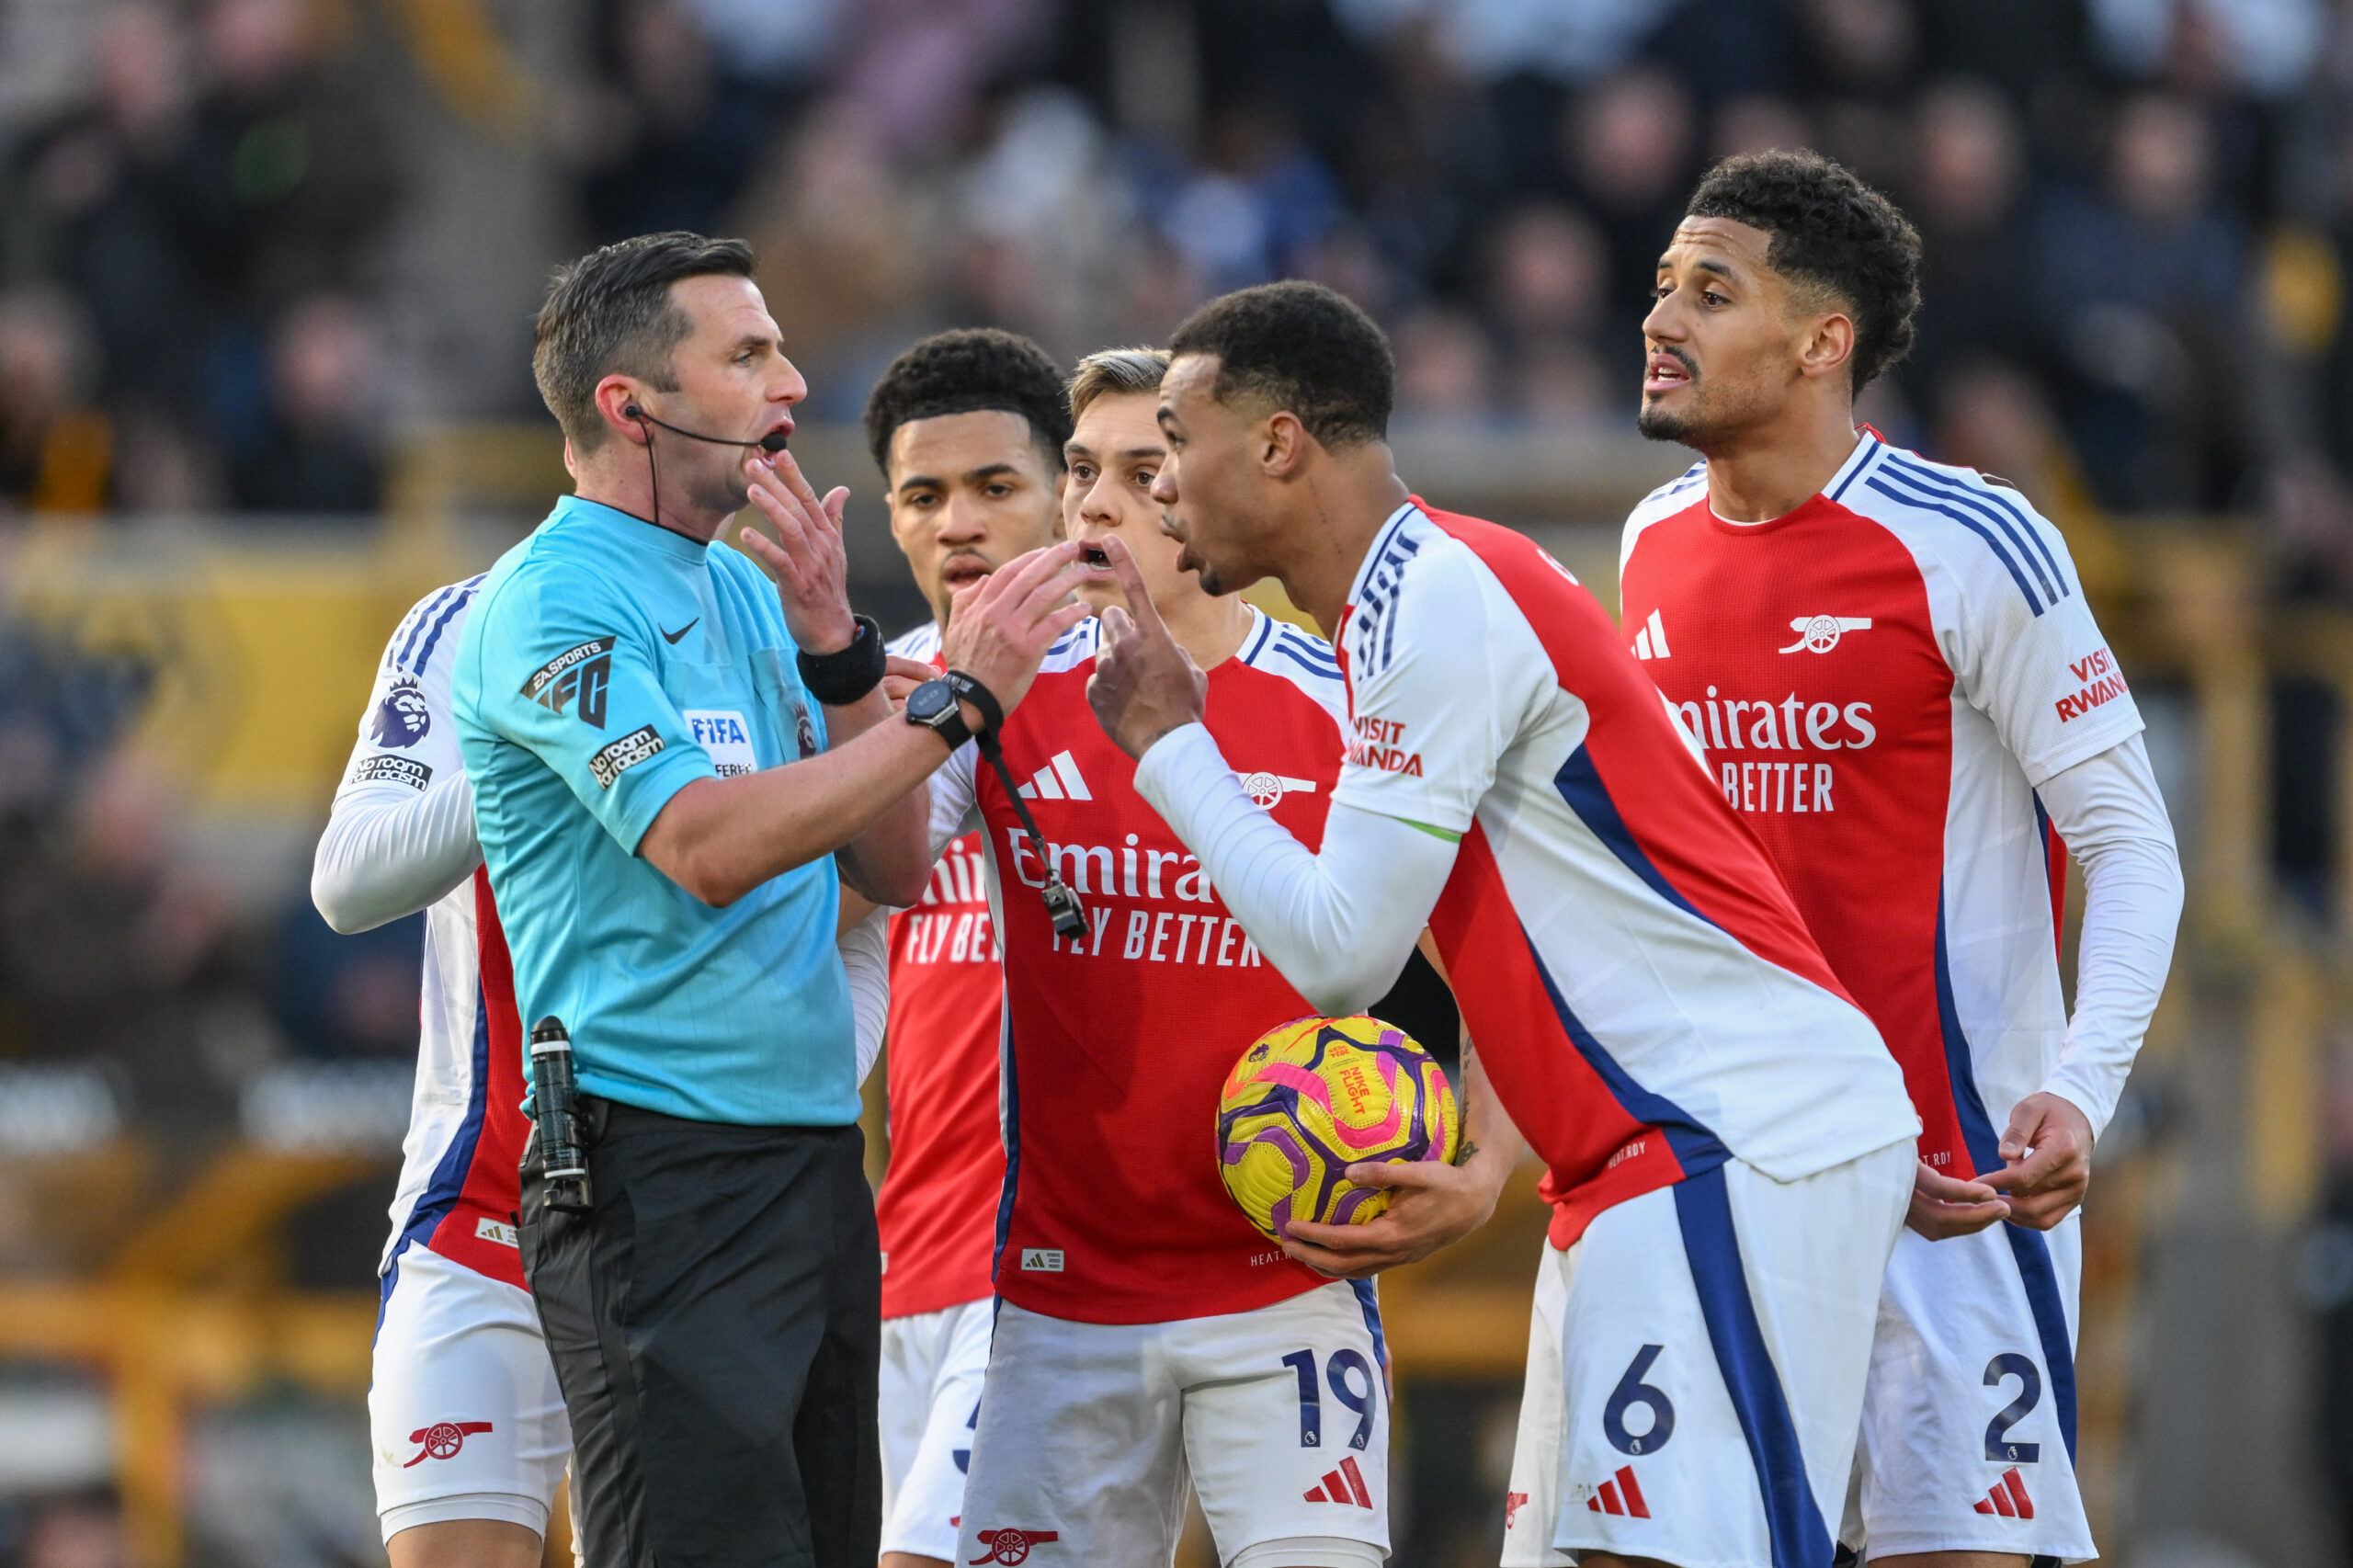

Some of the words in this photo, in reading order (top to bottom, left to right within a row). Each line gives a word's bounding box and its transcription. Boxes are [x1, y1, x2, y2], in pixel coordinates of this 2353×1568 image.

[533, 670, 552, 690] EA
[548, 642, 601, 676] SPORTS
[2069, 647, 2114, 683] VISIT
[536, 653, 611, 731] FC
[2055, 671, 2129, 723] RWAND
[691, 718, 746, 744] FIFA
[1353, 716, 1406, 744] VISIT
[1667, 685, 1877, 751] irates
[376, 756, 424, 778] room
[589, 756, 608, 773] No
[603, 730, 652, 762] room
[610, 737, 665, 776] racism
[714, 764, 753, 778] FEREE
[370, 768, 427, 791] racism
[1722, 762, 1835, 812] BETTER
[1007, 827, 1215, 903] Emira
[906, 915, 953, 964] FLY
[1339, 1070, 1366, 1114] FLIGHT
[1350, 1066, 1370, 1097] NIKE
[1281, 1348, 1376, 1451] 19
[1603, 1344, 1676, 1456] 6
[1983, 1352, 2041, 1463] 2
